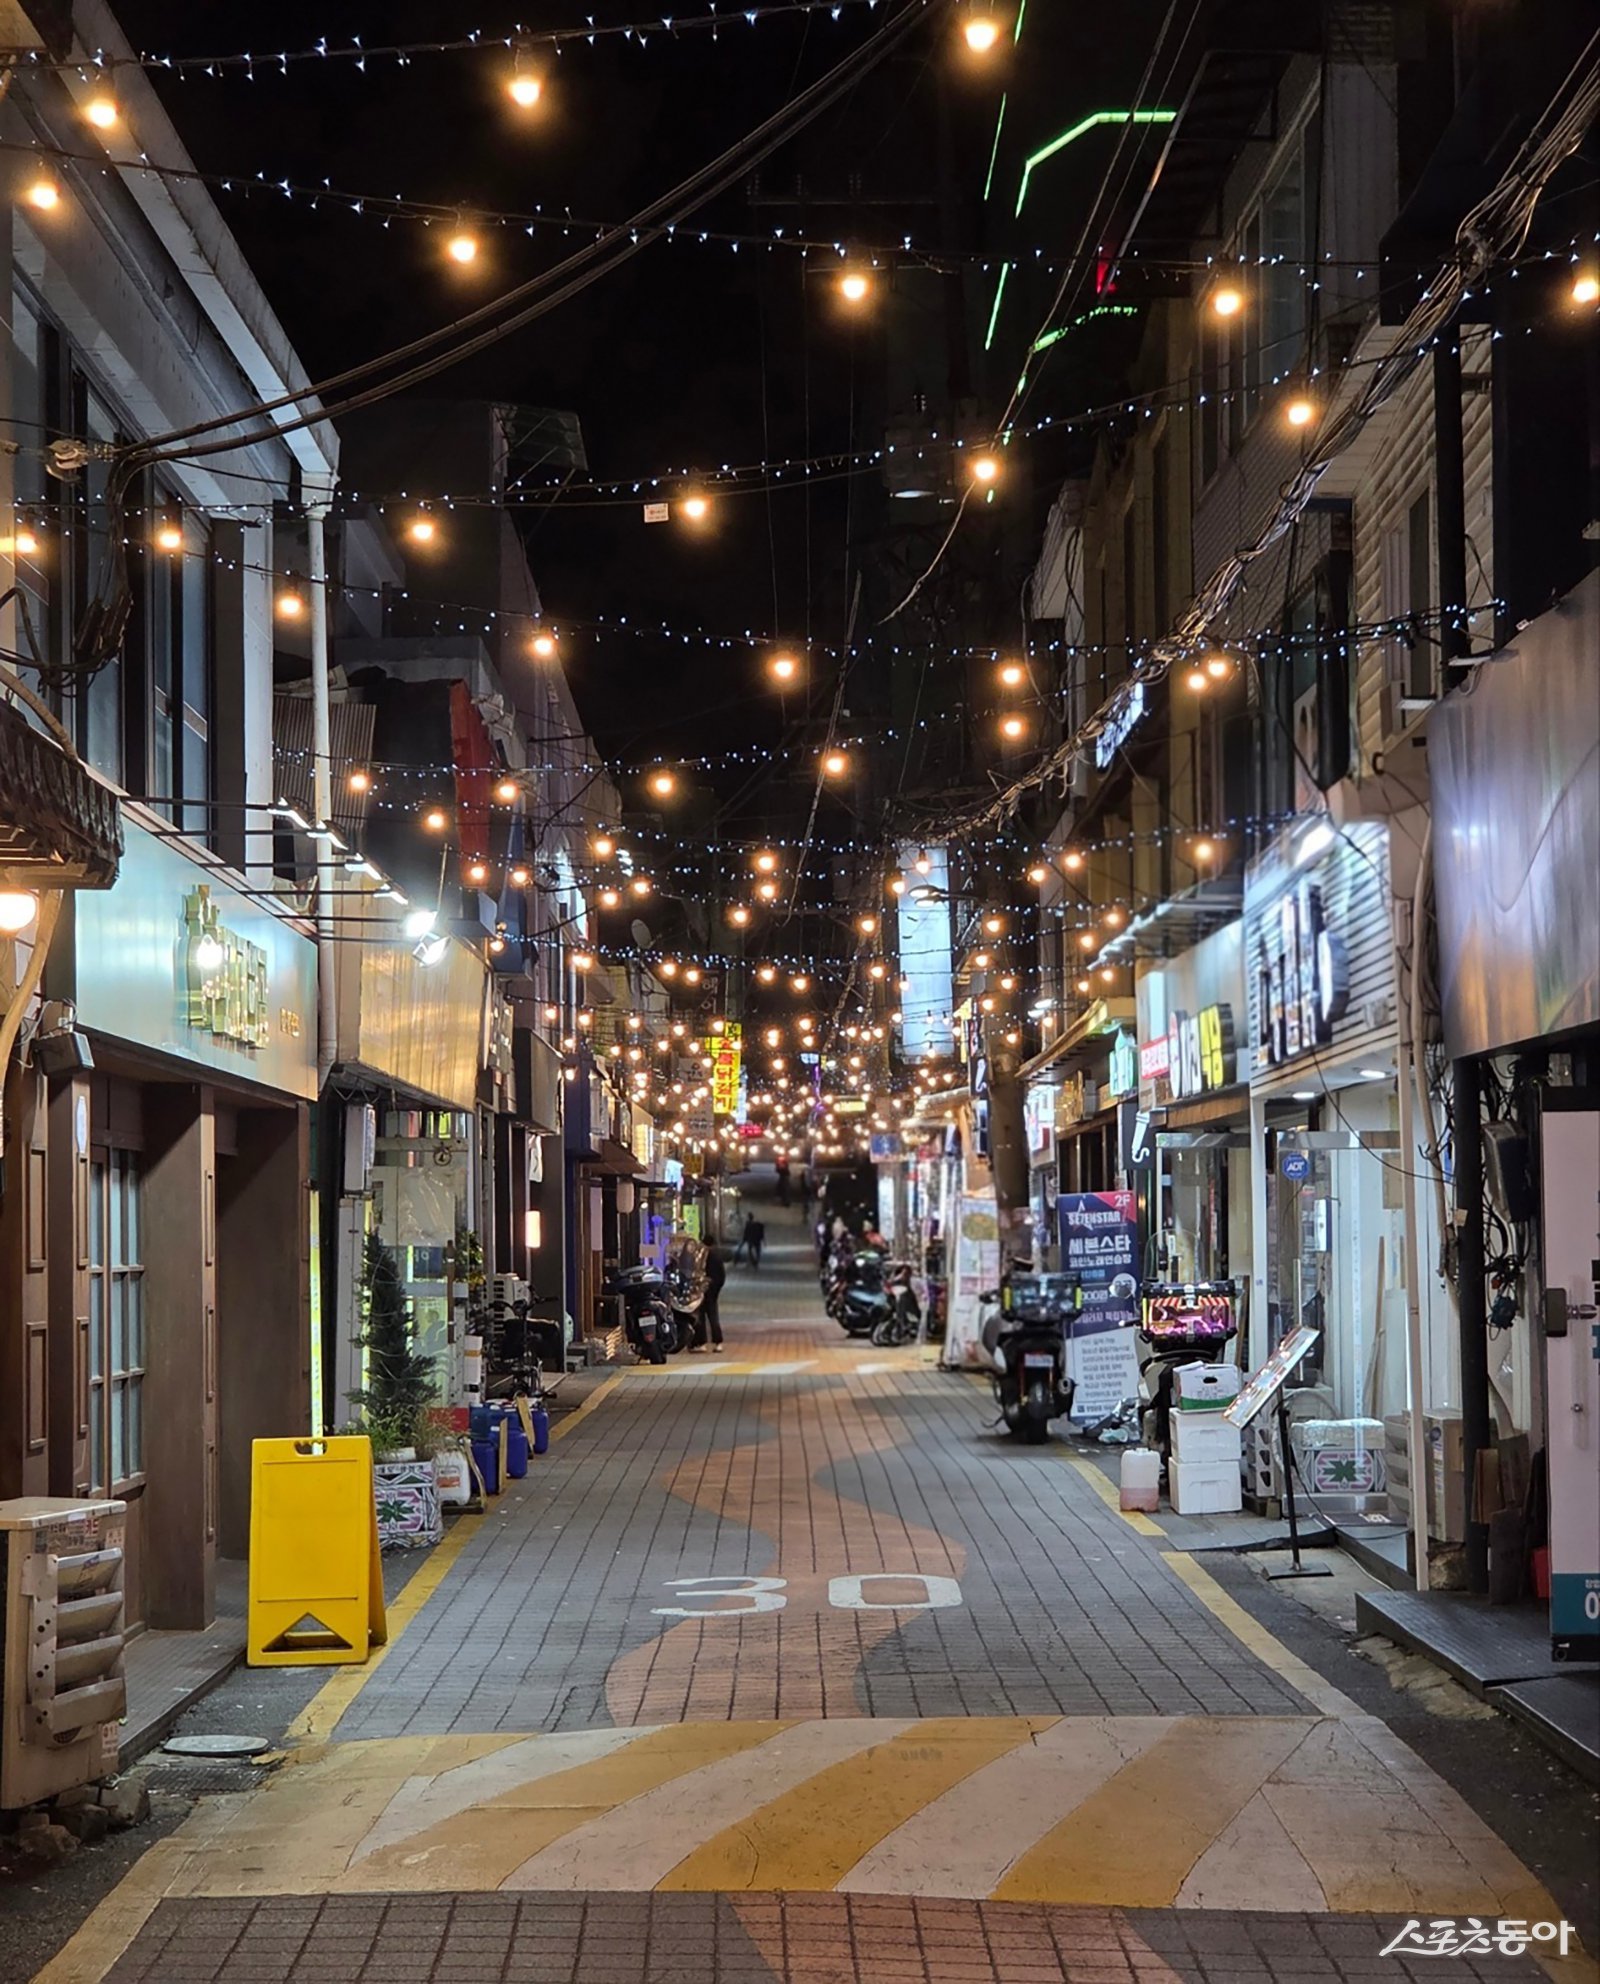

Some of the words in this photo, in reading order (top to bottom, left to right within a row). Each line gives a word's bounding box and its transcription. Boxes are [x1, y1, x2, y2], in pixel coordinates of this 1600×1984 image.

[1114, 1194, 1131, 1207] 2F
[1068, 1234, 1131, 1255] 세븐스타
[1585, 1591, 1600, 1619] 0
